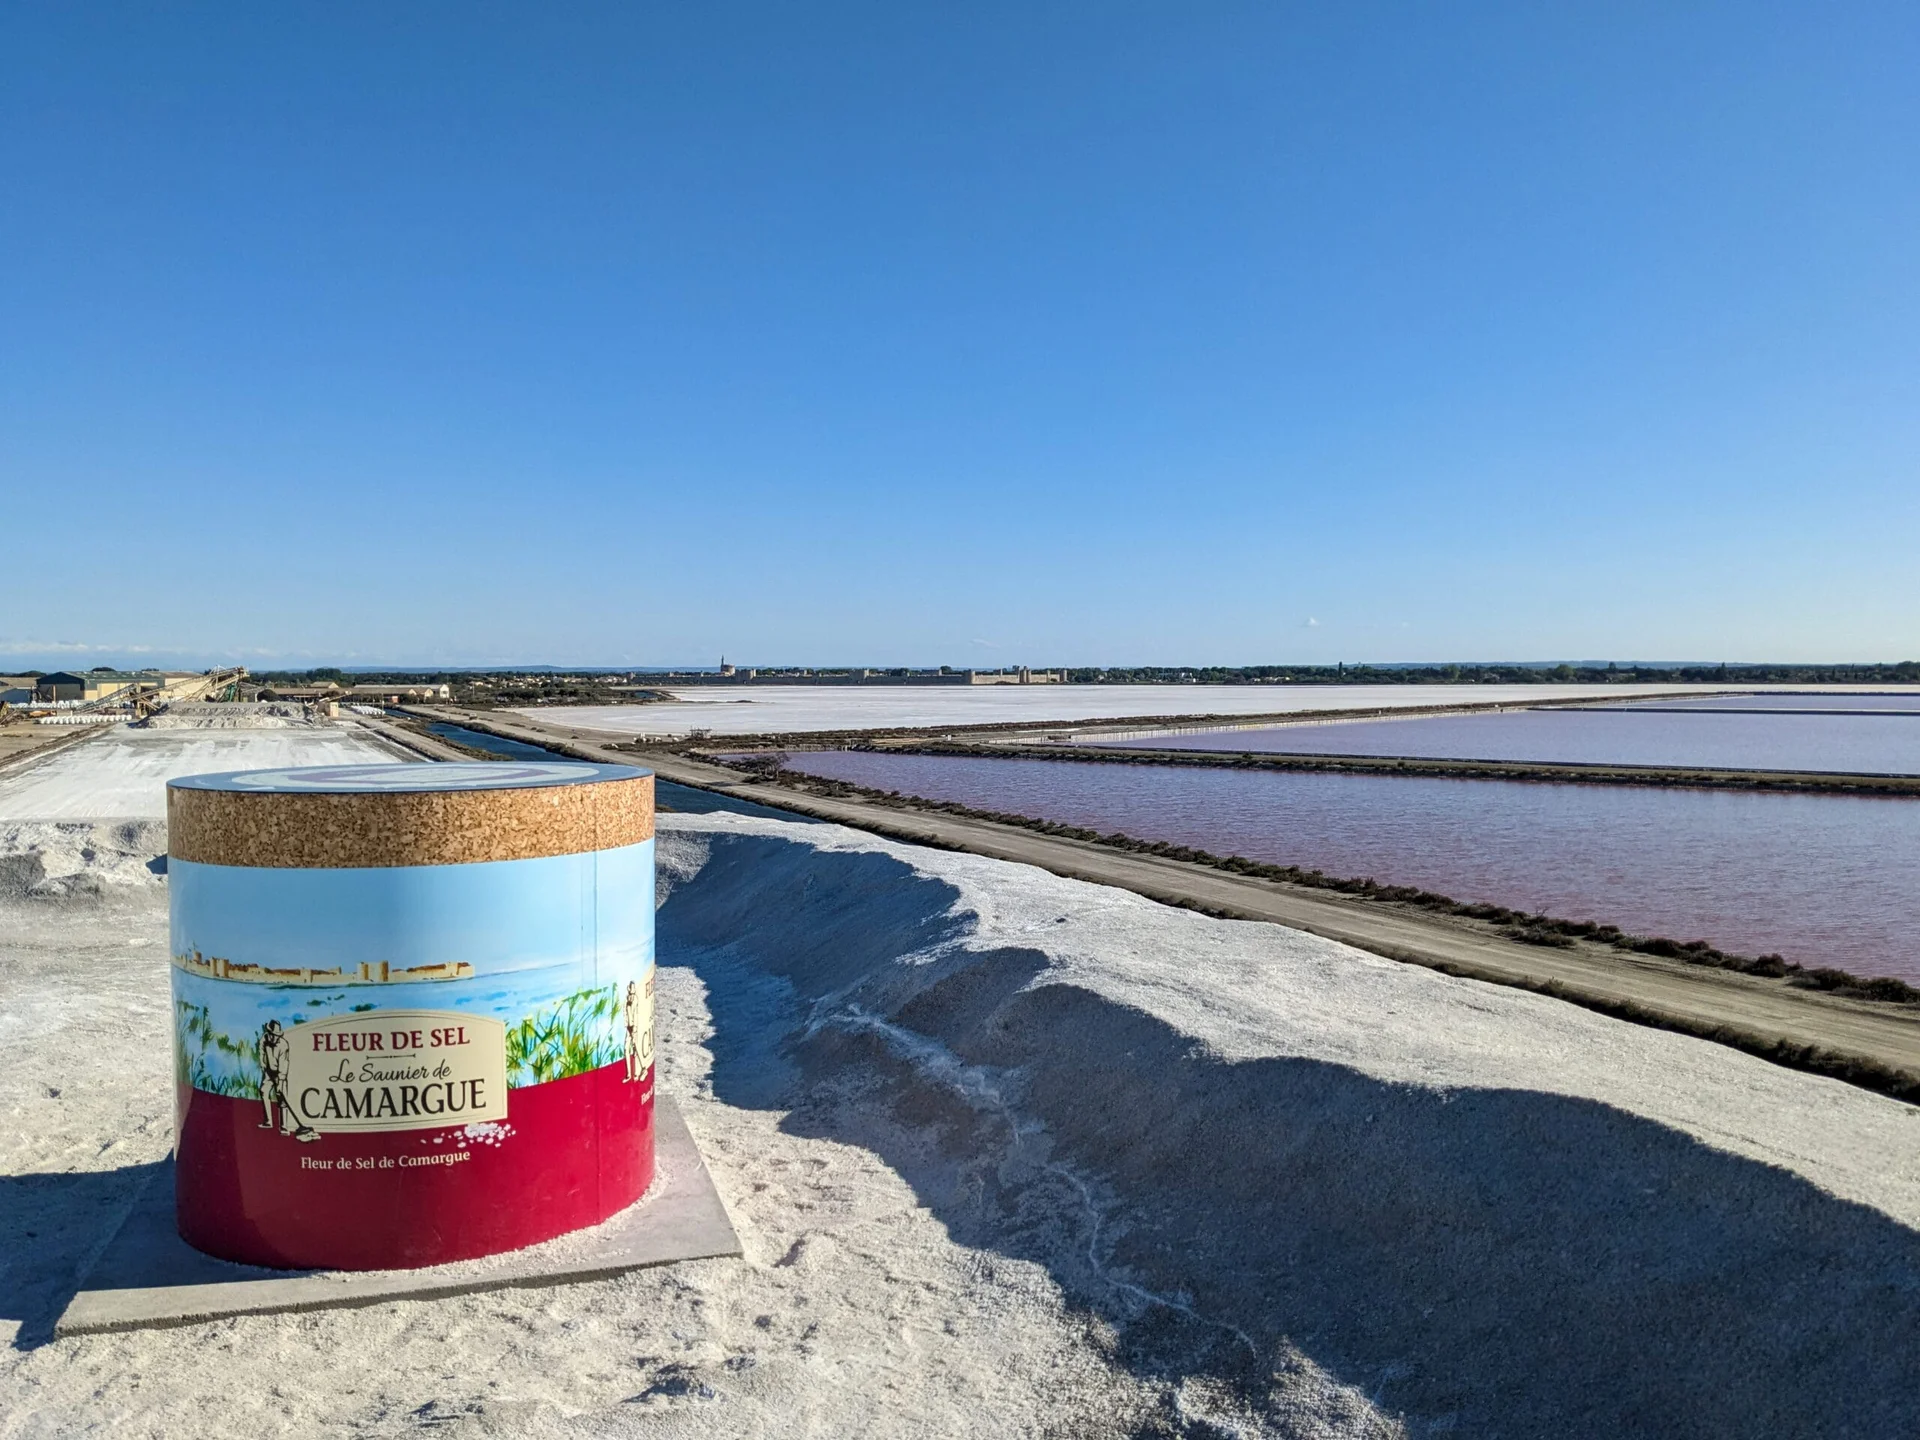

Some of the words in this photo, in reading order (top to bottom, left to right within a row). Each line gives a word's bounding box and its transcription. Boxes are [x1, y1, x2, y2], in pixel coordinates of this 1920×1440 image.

[312, 1033, 384, 1051] FLEUR
[390, 1030, 423, 1050] DE
[430, 1027, 470, 1047] SEL
[329, 1059, 355, 1083] Le
[359, 1063, 429, 1082] Saunier
[432, 1059, 452, 1080] de
[300, 1079, 487, 1119] CAMARGUE
[301, 1156, 333, 1169] Fleur
[336, 1157, 352, 1169] de
[355, 1155, 375, 1169] Sel
[378, 1155, 395, 1168] de
[399, 1151, 471, 1166] Camargue
